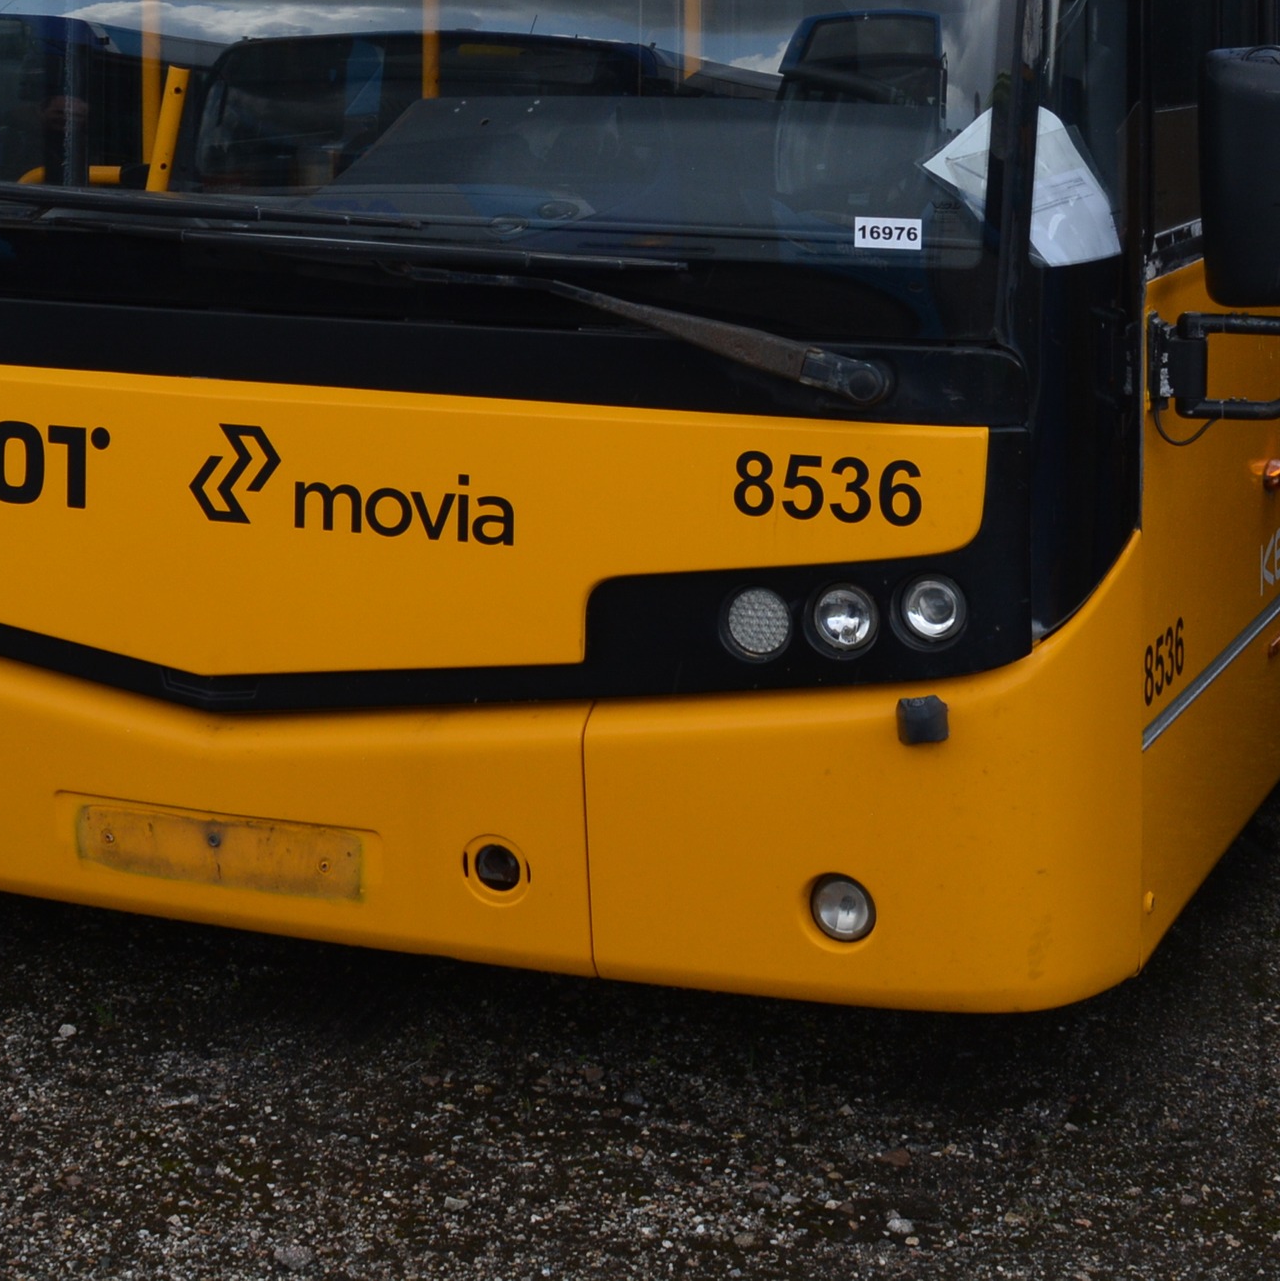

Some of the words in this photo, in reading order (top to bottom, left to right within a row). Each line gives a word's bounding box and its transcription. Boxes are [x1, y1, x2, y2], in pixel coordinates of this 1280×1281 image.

[858, 224, 918, 241] 16976
[294, 473, 515, 547] movia
[733, 450, 923, 527] 8536
[1144, 617, 1185, 707] 8536
